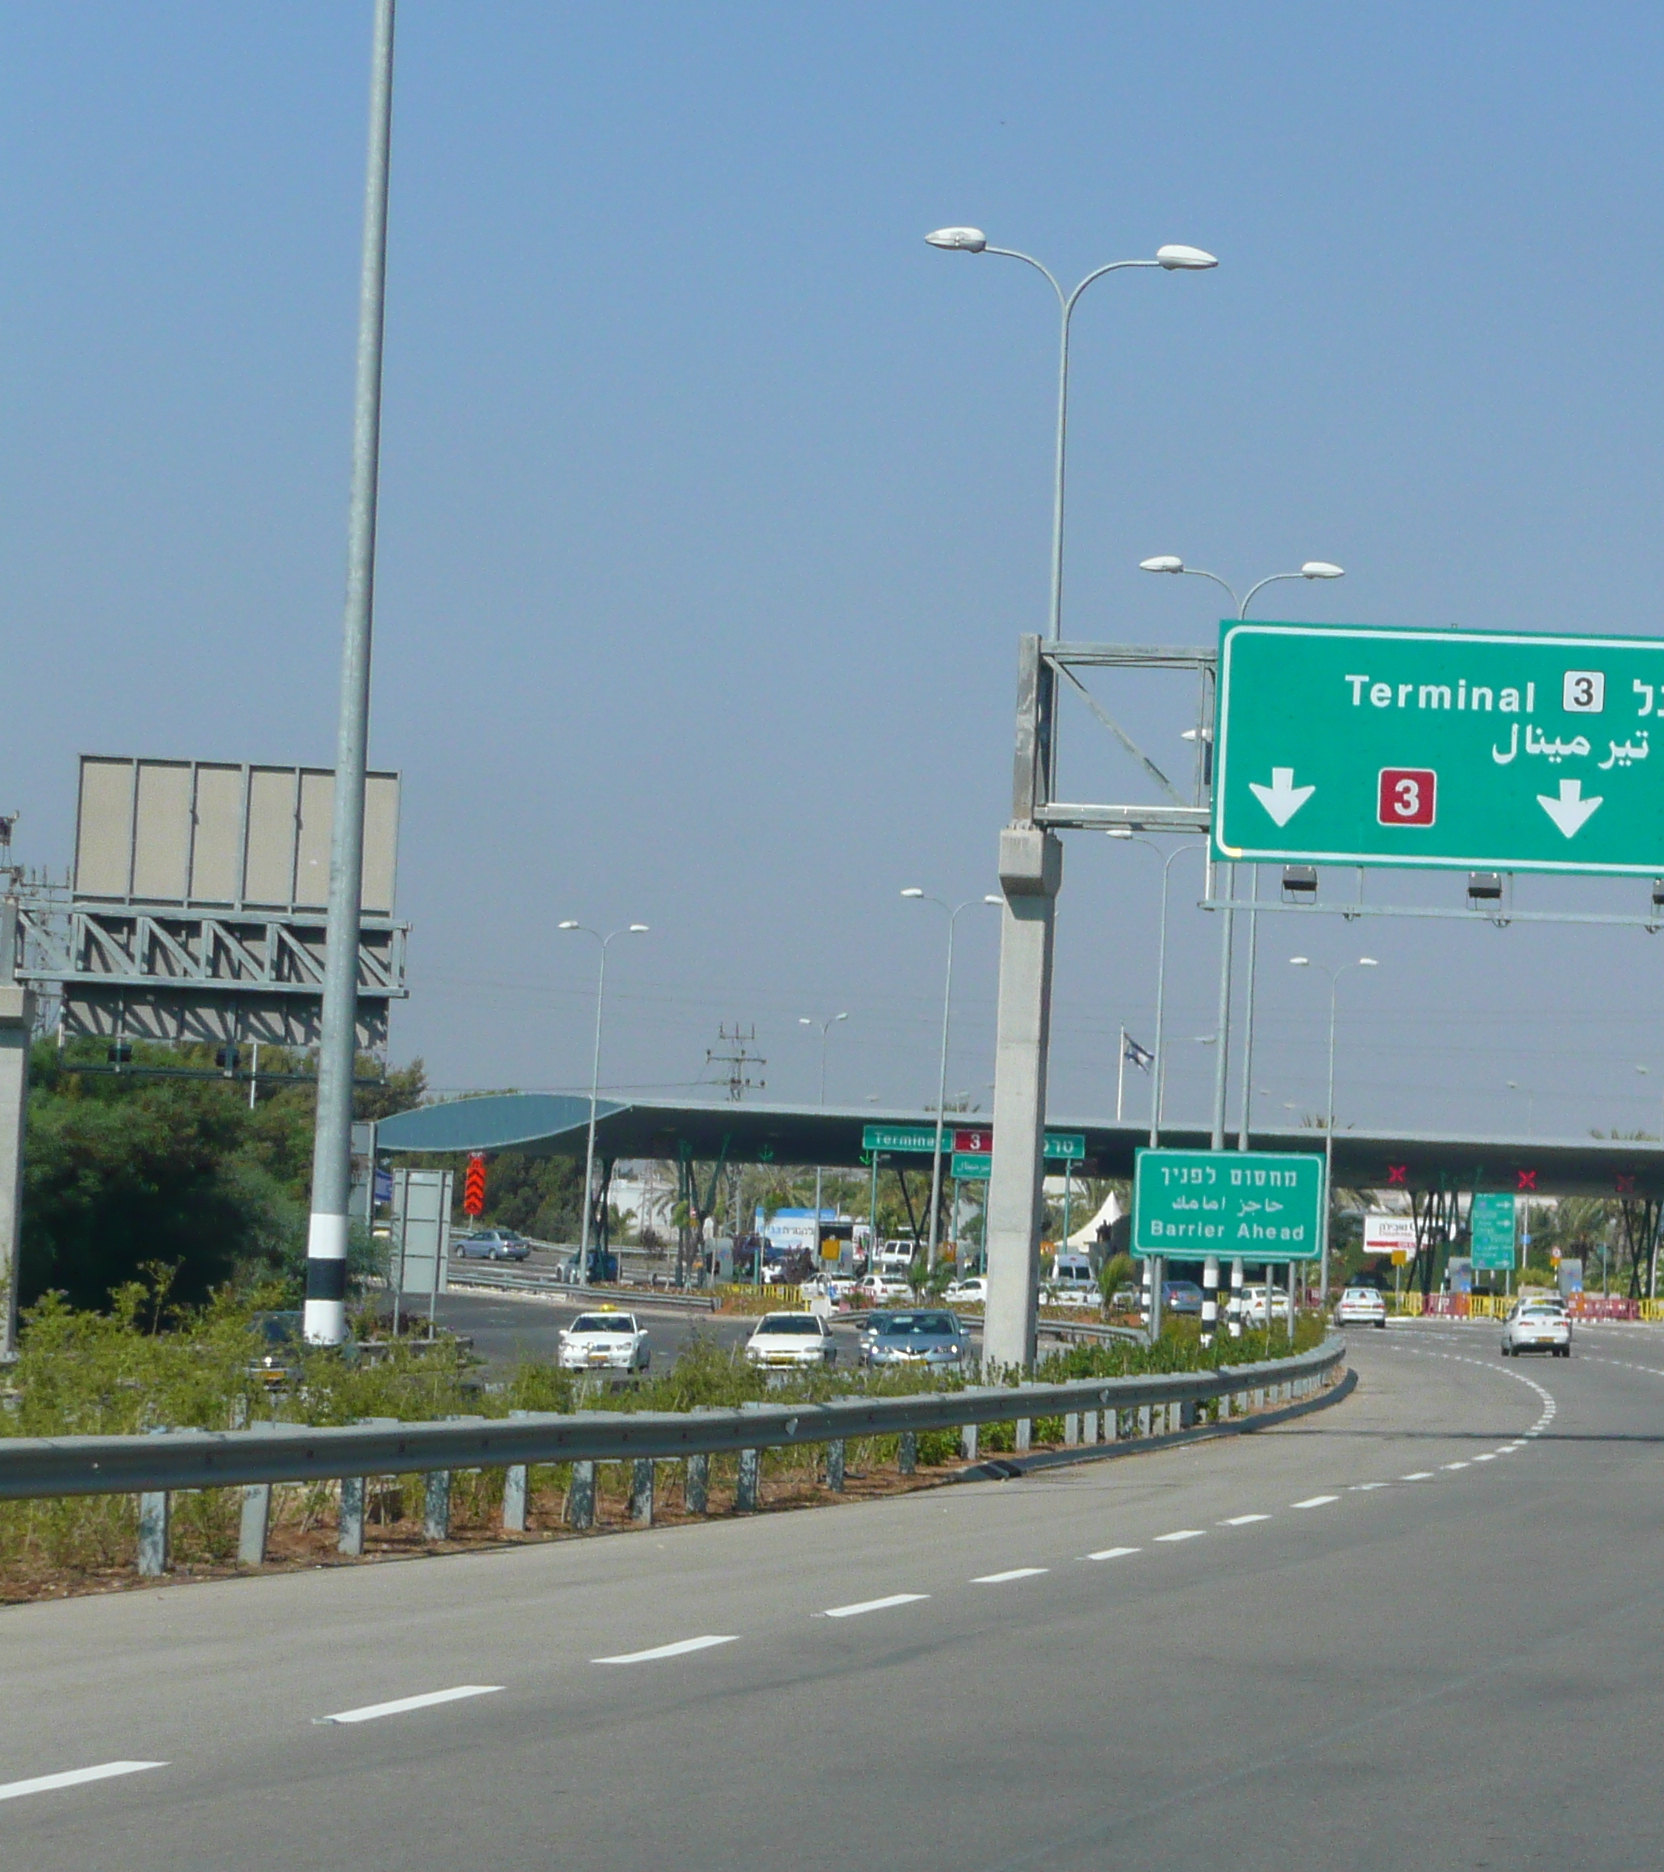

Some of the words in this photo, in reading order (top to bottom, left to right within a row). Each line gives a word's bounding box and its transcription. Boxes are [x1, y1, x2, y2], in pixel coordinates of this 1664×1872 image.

[1344, 674, 1536, 713] Terminal
[1573, 676, 1595, 707] 3
[1393, 778, 1420, 817] 3
[875, 1132, 938, 1149] Termina
[969, 1133, 981, 1150] 3
[1160, 1165, 1217, 1186] לפניך
[1230, 1168, 1298, 1188] מחסום
[1237, 1197, 1284, 1217] حاجز
[1150, 1219, 1225, 1238] Barrier
[1236, 1222, 1305, 1241] Ahead
